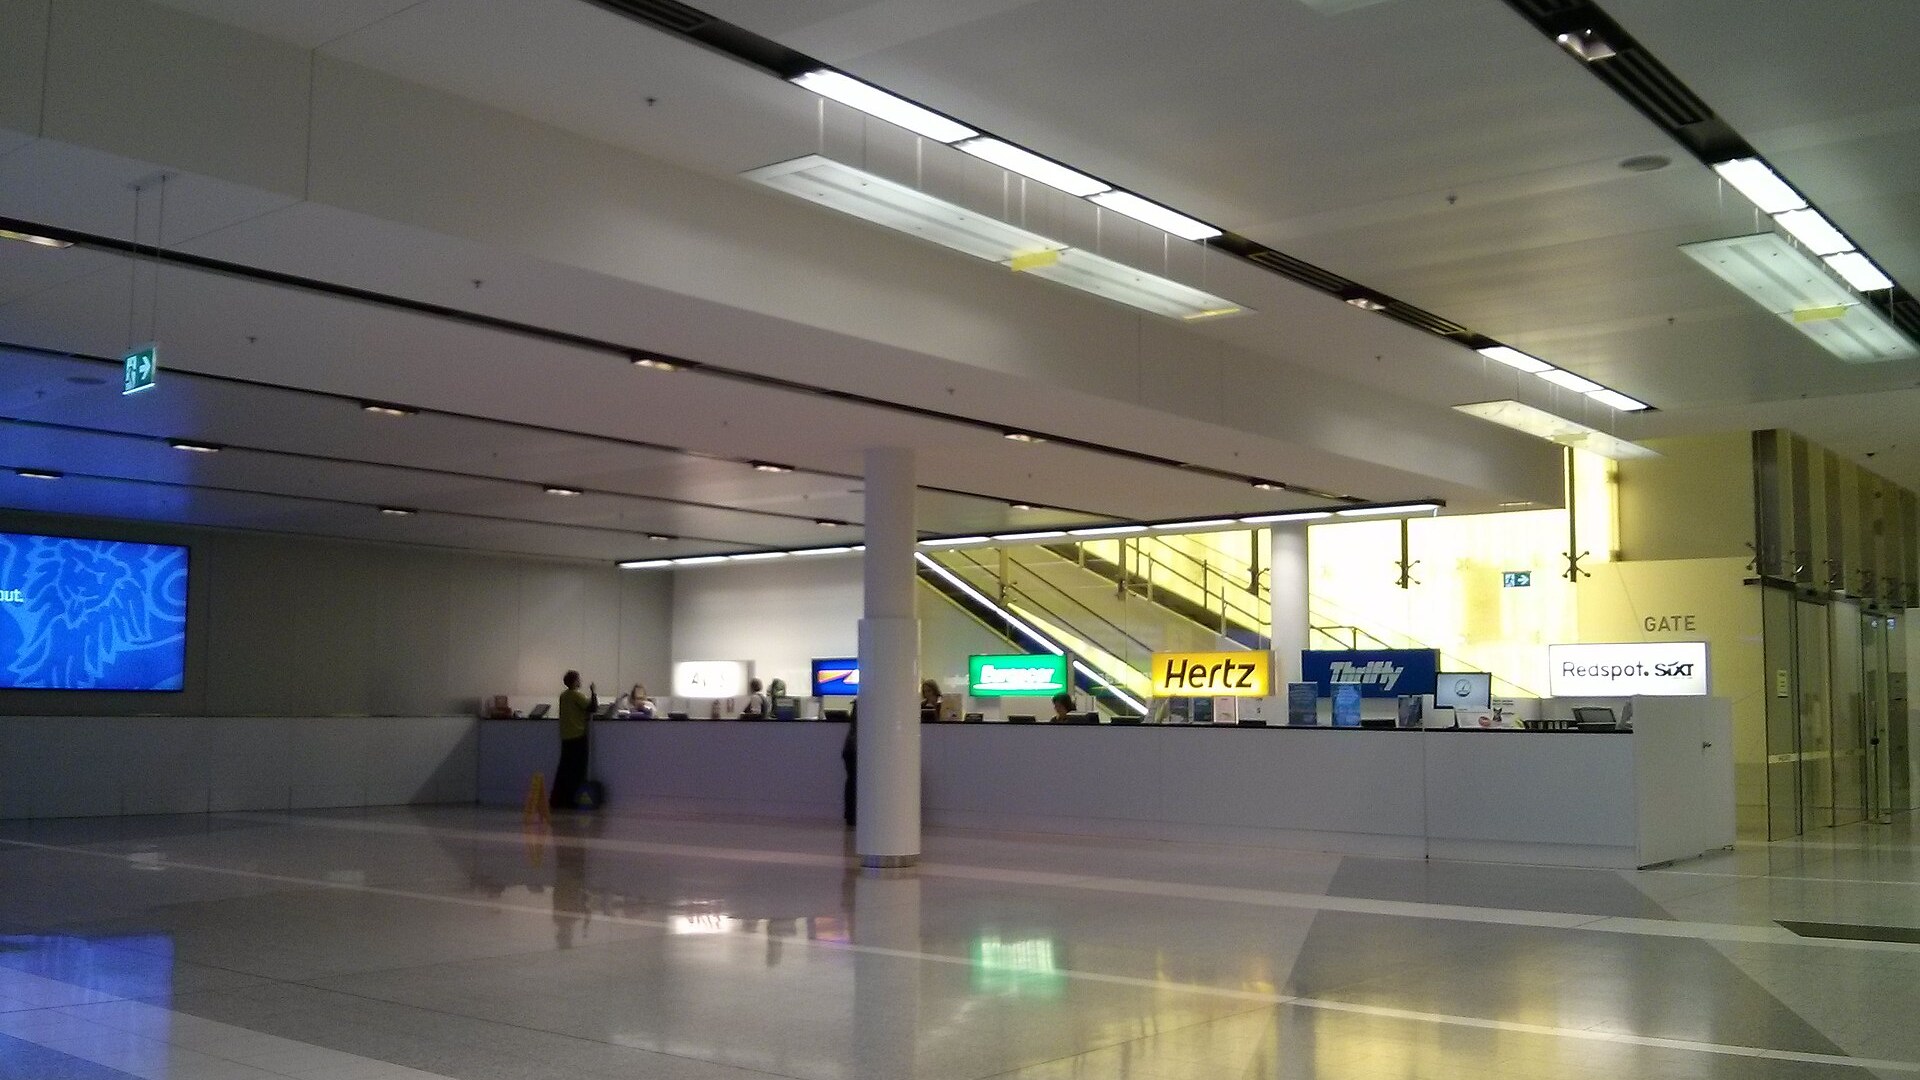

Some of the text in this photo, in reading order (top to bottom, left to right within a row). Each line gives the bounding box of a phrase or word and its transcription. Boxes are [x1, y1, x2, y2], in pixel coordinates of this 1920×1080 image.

[1644, 615, 1696, 632] GATE
[1164, 658, 1256, 689] Hertz
[1329, 661, 1404, 691] Thrifty
